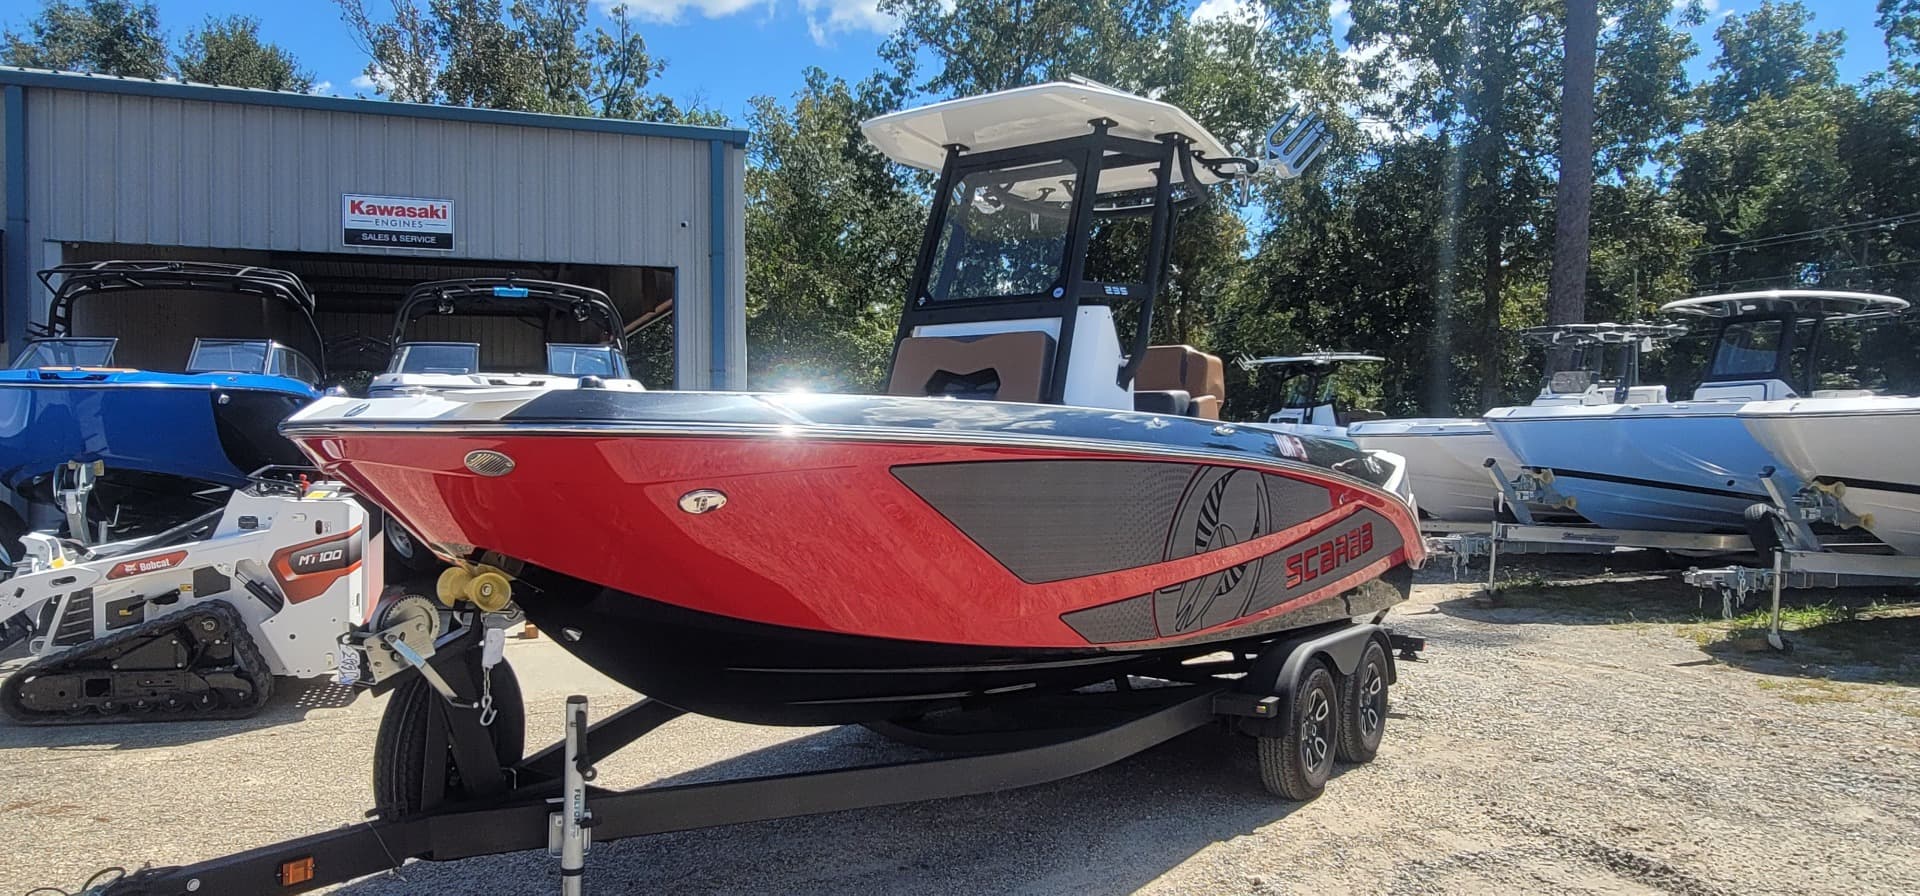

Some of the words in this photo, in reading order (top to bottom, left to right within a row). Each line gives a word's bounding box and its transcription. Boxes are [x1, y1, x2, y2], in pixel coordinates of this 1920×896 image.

[350, 199, 447, 220] Kawasaki
[375, 218, 423, 229] ENGINES
[361, 232, 390, 242] SALES
[391, 234, 398, 243] &
[399, 234, 438, 244] SERVICE
[139, 558, 170, 572] Bobcat
